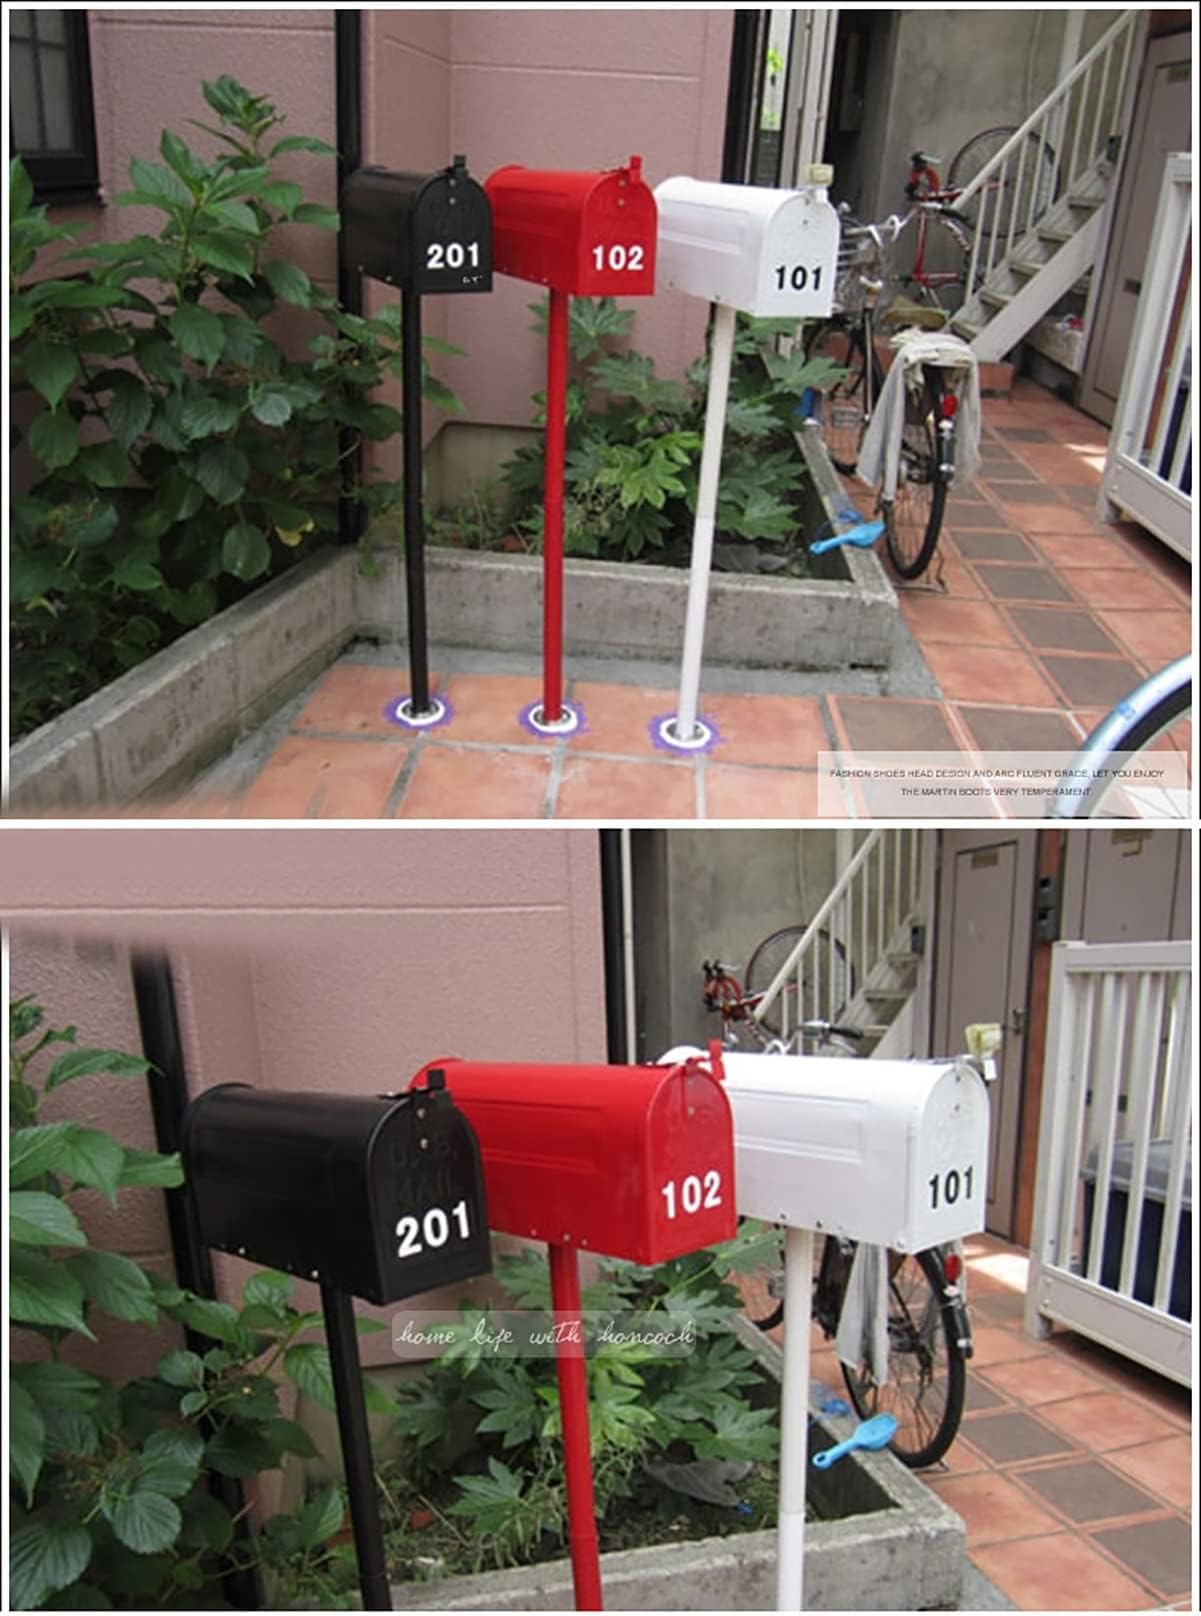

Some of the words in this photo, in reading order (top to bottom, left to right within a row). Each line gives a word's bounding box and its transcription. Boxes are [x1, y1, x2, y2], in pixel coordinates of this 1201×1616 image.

[426, 242, 480, 270] 201
[592, 245, 645, 272] 102
[775, 265, 823, 292] 101
[660, 1169, 724, 1220] 102
[928, 1165, 975, 1211] 101
[394, 1200, 471, 1259] 201
